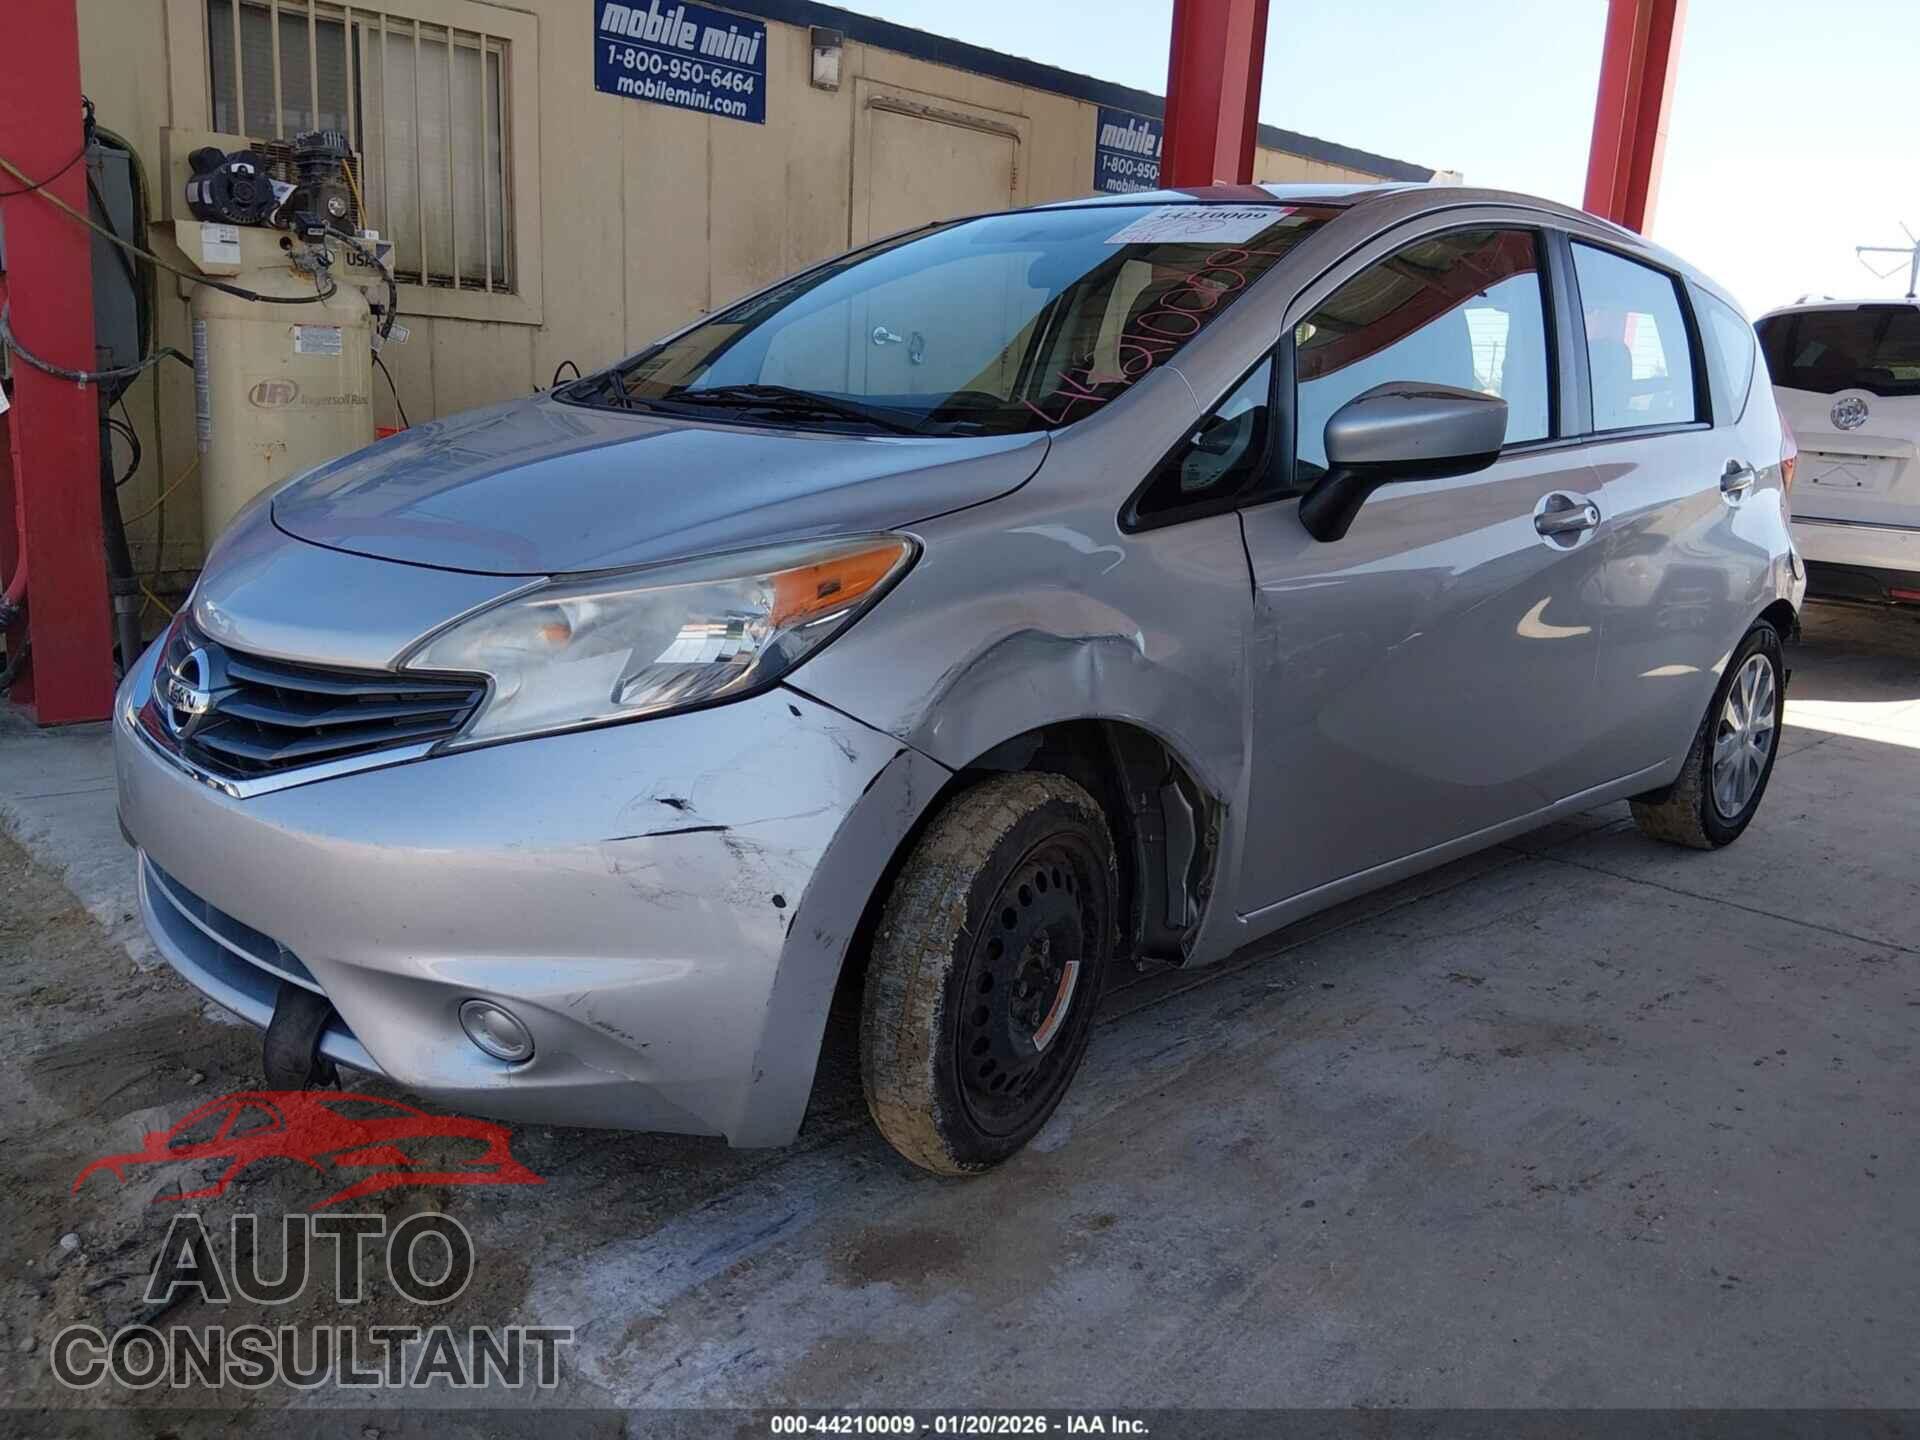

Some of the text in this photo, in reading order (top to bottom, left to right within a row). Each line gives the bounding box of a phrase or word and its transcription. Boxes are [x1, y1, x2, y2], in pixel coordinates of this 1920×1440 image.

[600, 0, 762, 65] mobile mini
[608, 45, 754, 94] 1-800-950-6464
[616, 76, 747, 117] mobilemini.com
[1099, 118, 1156, 155] mobile
